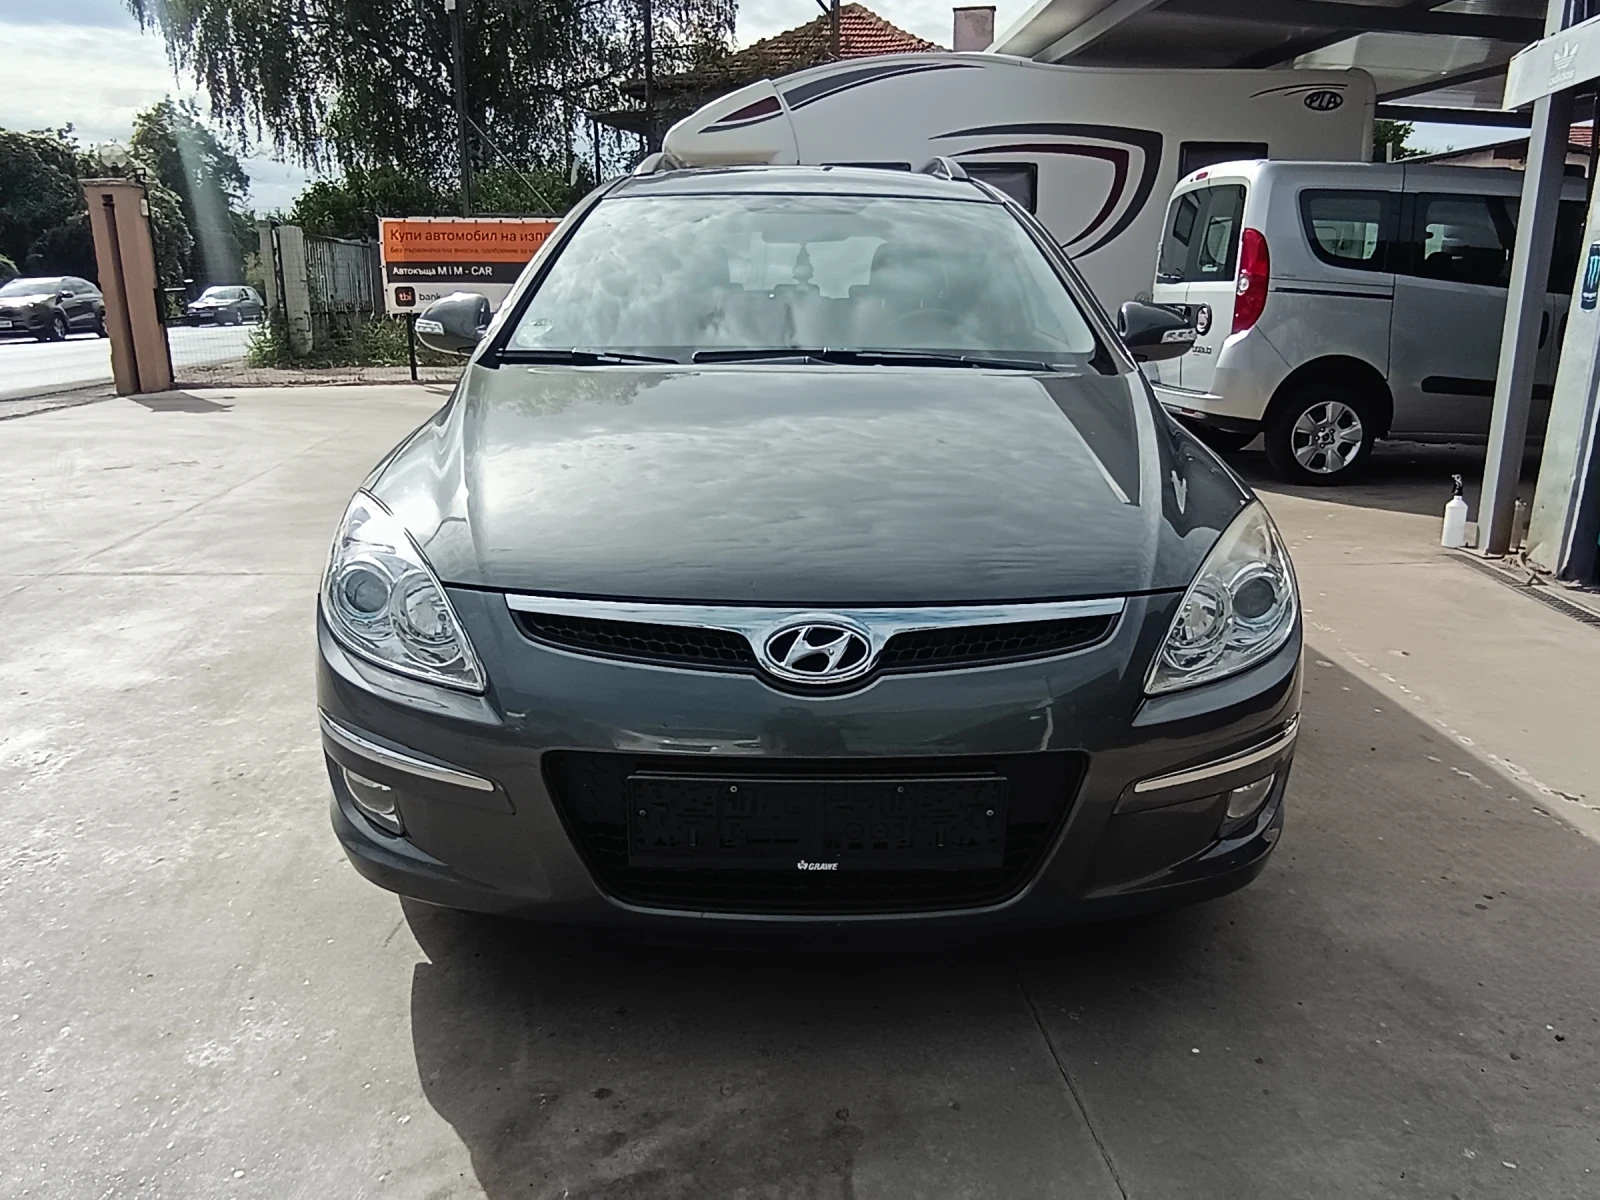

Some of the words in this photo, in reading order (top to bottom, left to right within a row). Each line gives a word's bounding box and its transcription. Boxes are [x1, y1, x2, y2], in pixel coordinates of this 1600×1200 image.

[390, 229, 422, 242] Купи
[425, 230, 498, 242] автомобил
[501, 232, 517, 242] на
[392, 266, 436, 276] Автокъща
[471, 266, 493, 276] CAR
[398, 292, 412, 301] tbi
[419, 293, 441, 301] bank
[808, 862, 839, 871] GRAWE
